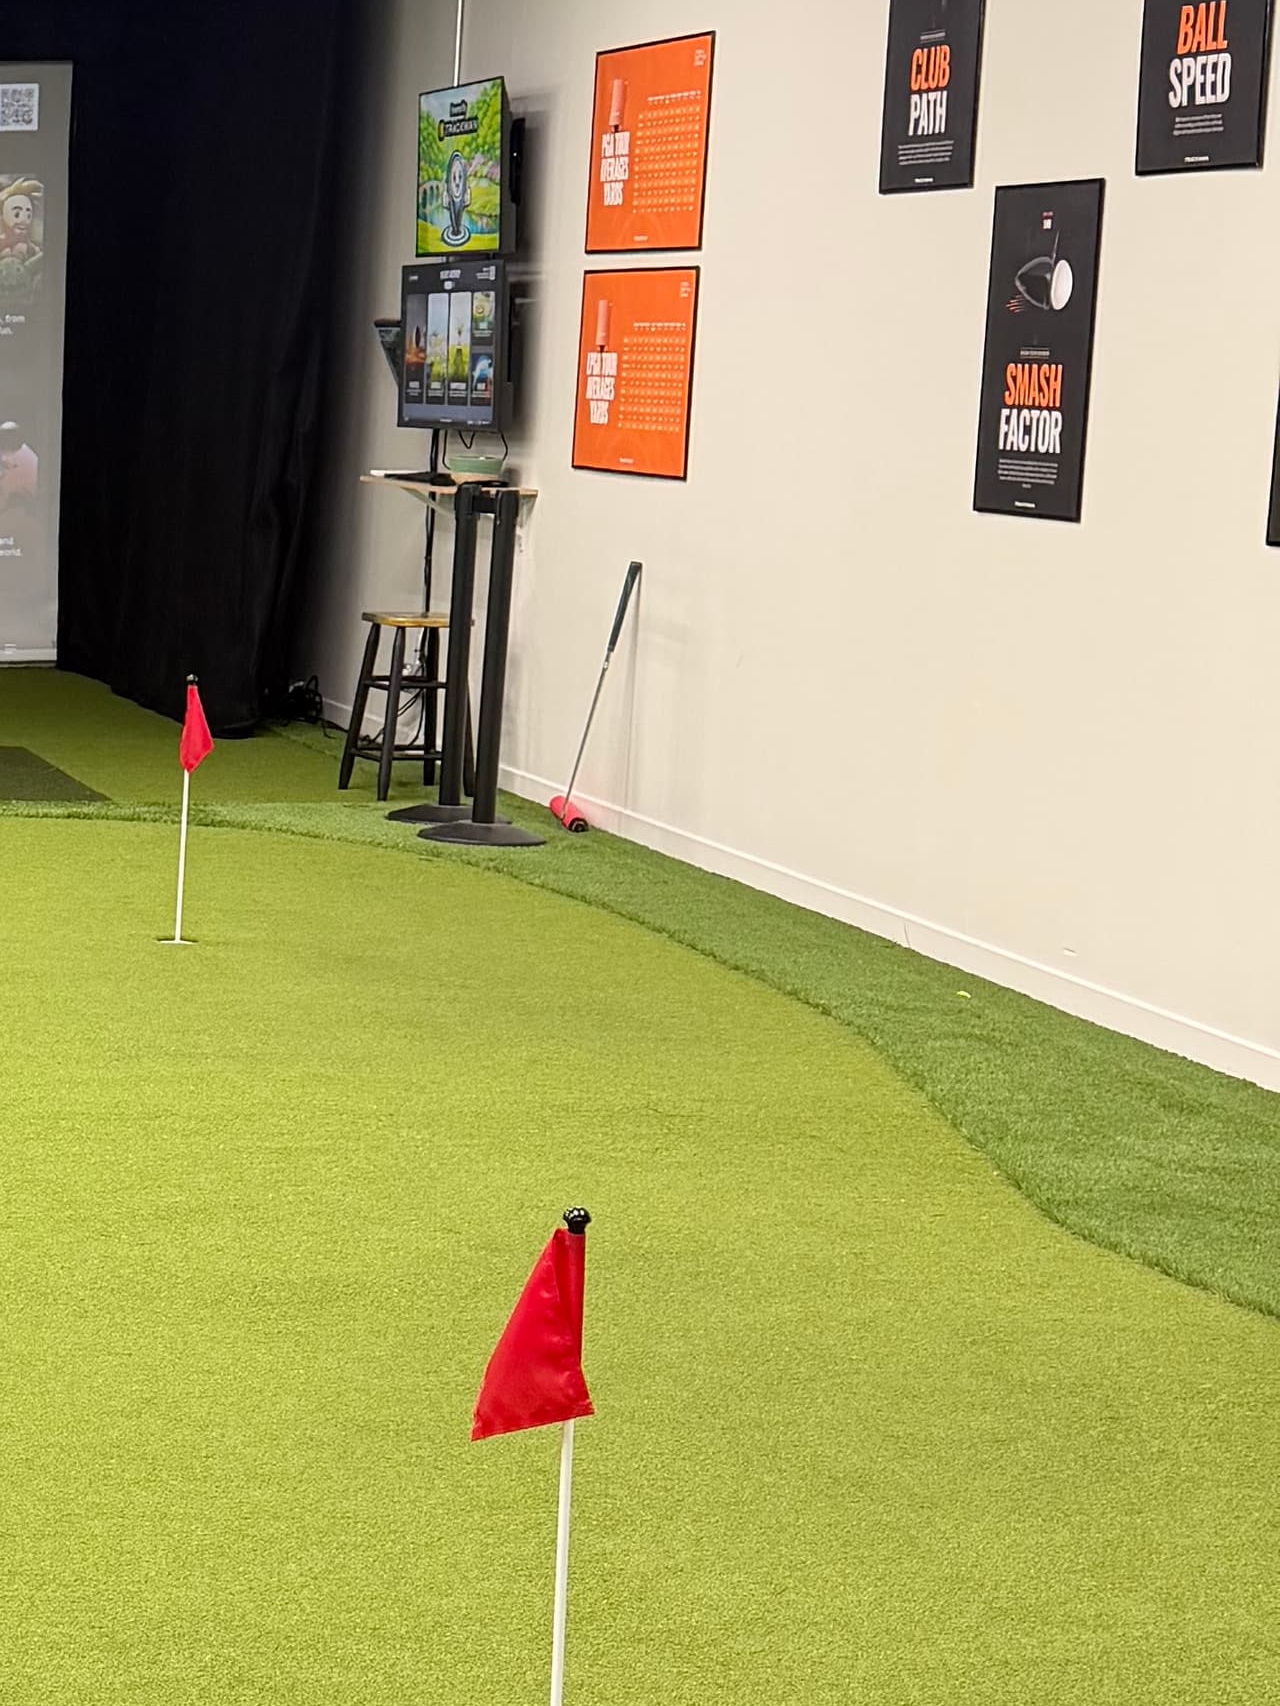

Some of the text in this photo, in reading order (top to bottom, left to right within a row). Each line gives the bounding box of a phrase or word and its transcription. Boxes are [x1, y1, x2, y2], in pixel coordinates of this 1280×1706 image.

[1177, 0, 1228, 55] BALL
[910, 45, 951, 92] CLUB
[1168, 53, 1232, 109] SPEED
[908, 91, 948, 136] PATH
[5, 314, 25, 324] from
[1004, 362, 1063, 408] SMASH
[998, 408, 1063, 454] FACTOR
